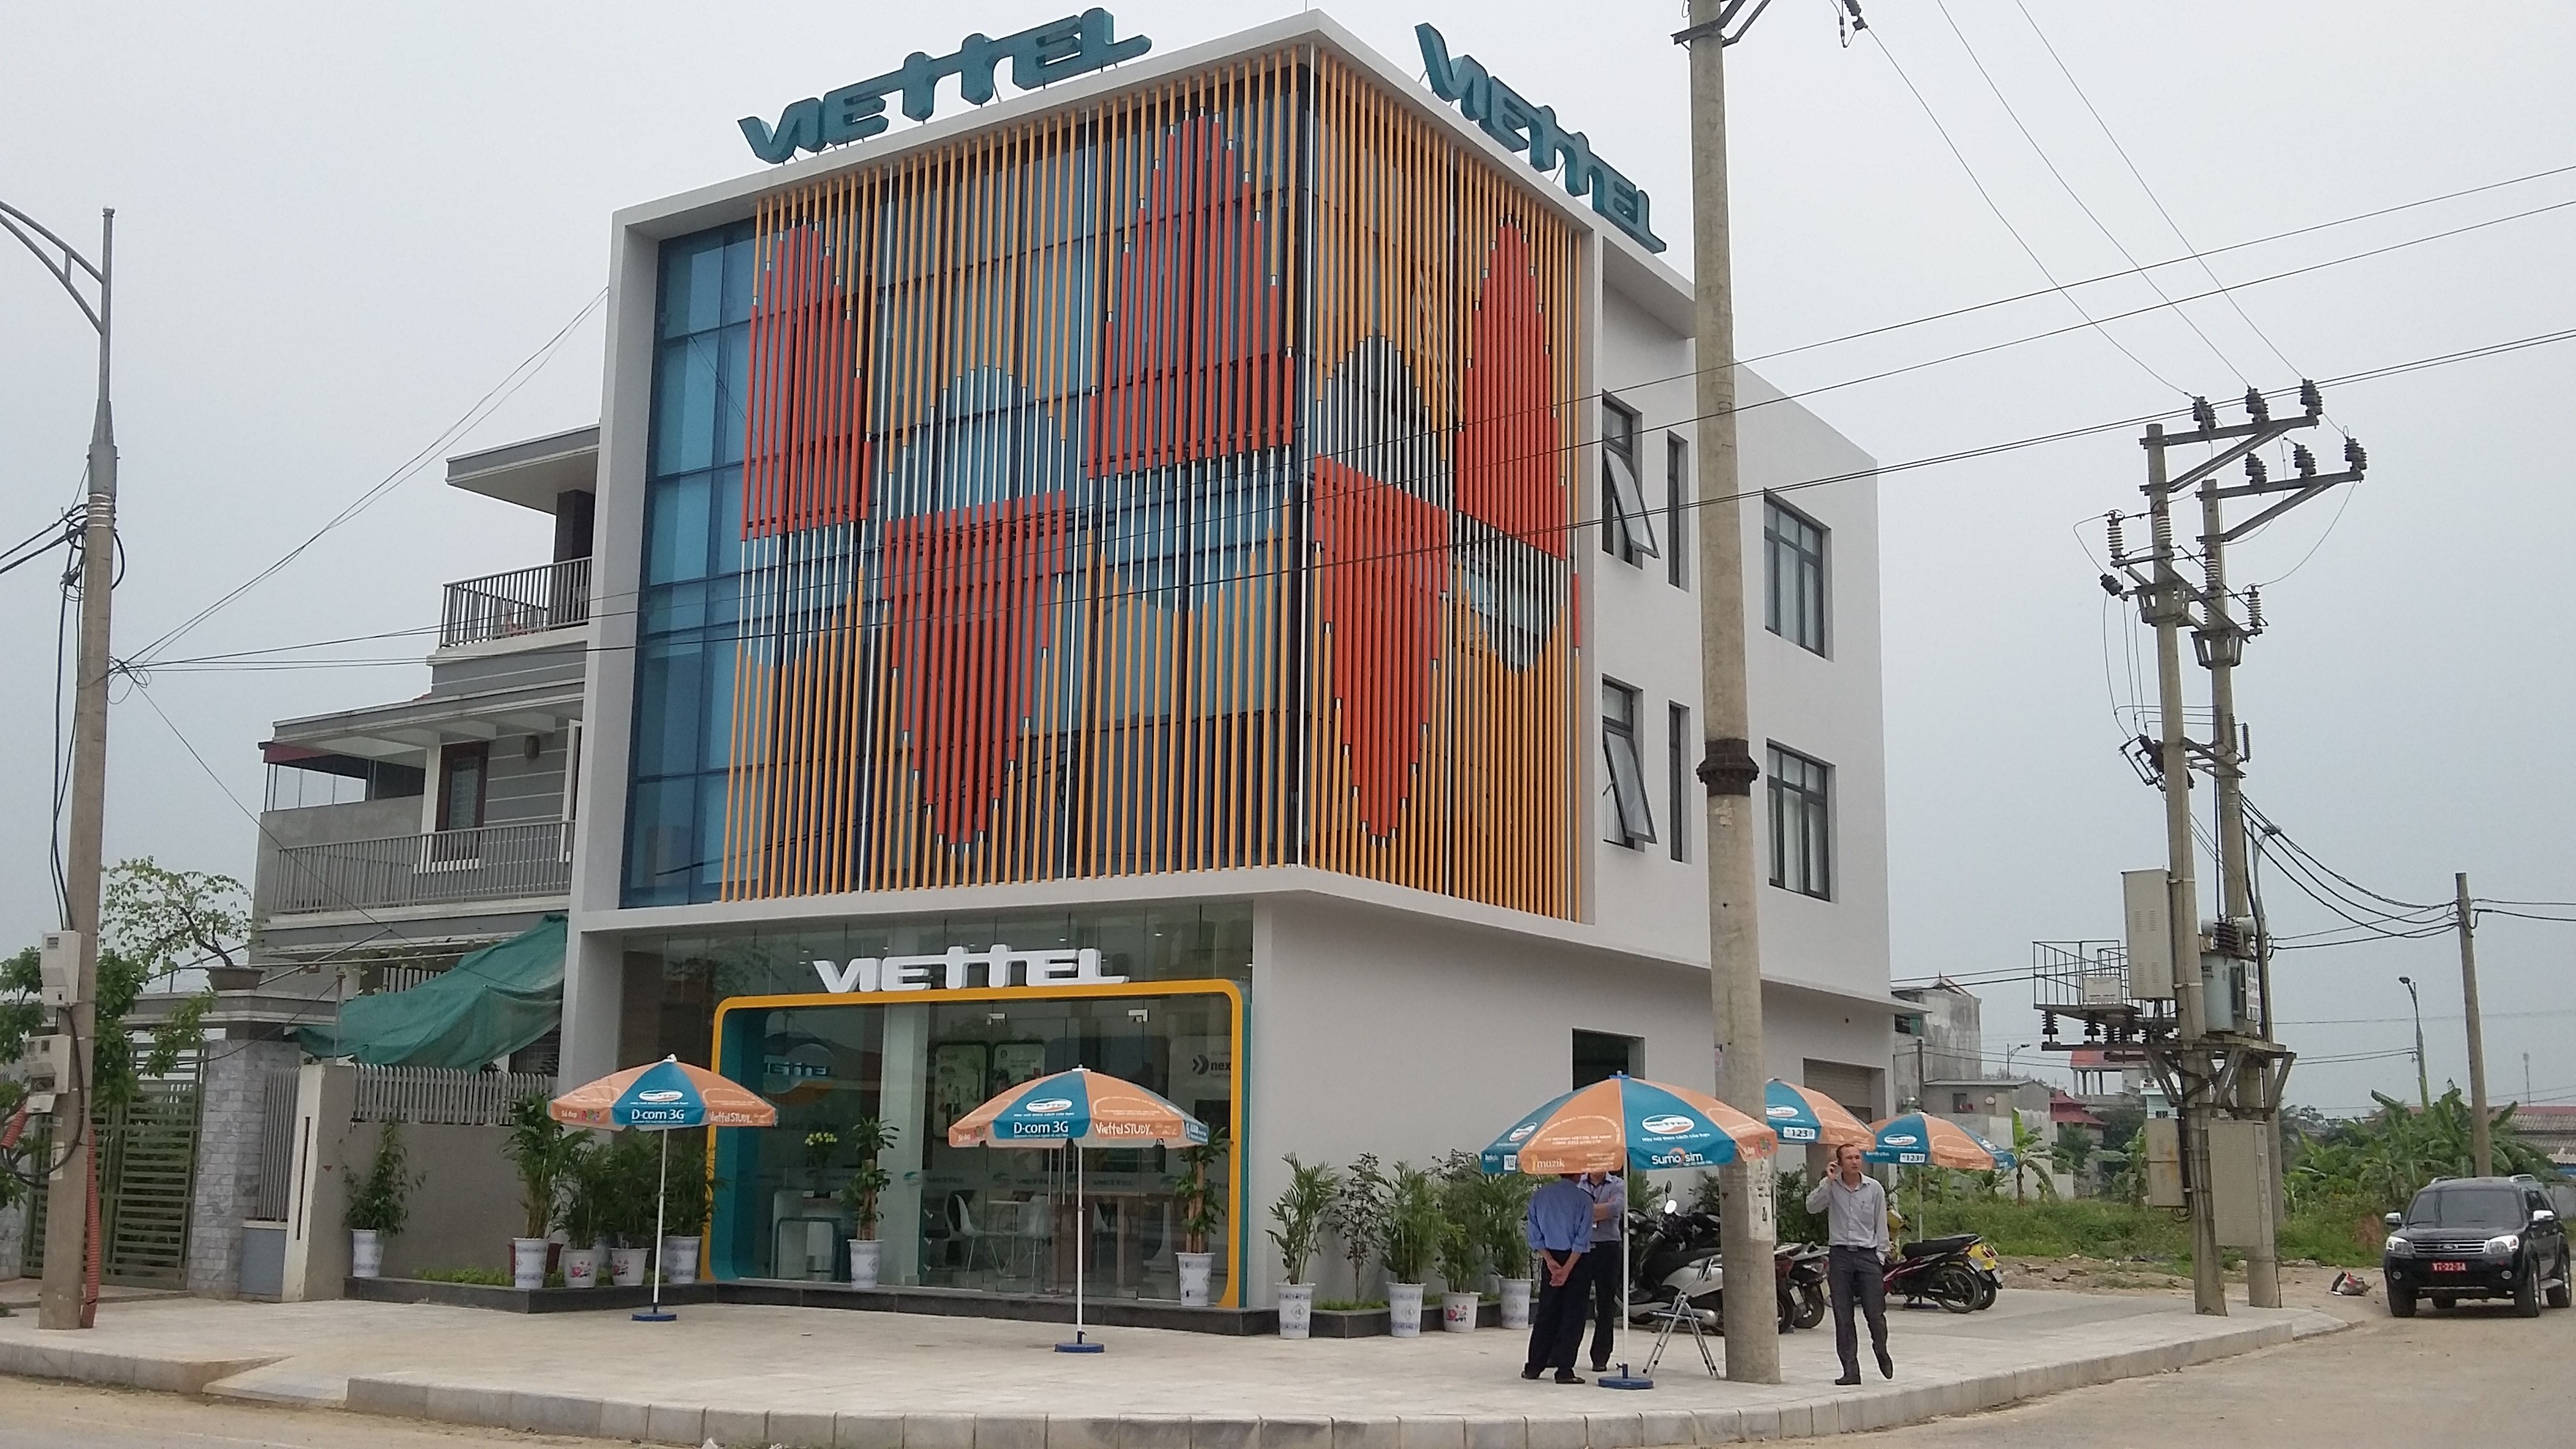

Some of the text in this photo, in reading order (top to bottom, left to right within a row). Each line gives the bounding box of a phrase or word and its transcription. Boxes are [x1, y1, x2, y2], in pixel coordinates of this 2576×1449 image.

[737, 7, 1152, 165] VIETTEL
[1414, 22, 1667, 254] VIETTEL
[813, 944, 1130, 994] VIETTEL
[668, 1109, 684, 1120] 3G
[1052, 1121, 1069, 1133] 3G
[1651, 1154, 1681, 1165] Sumo
